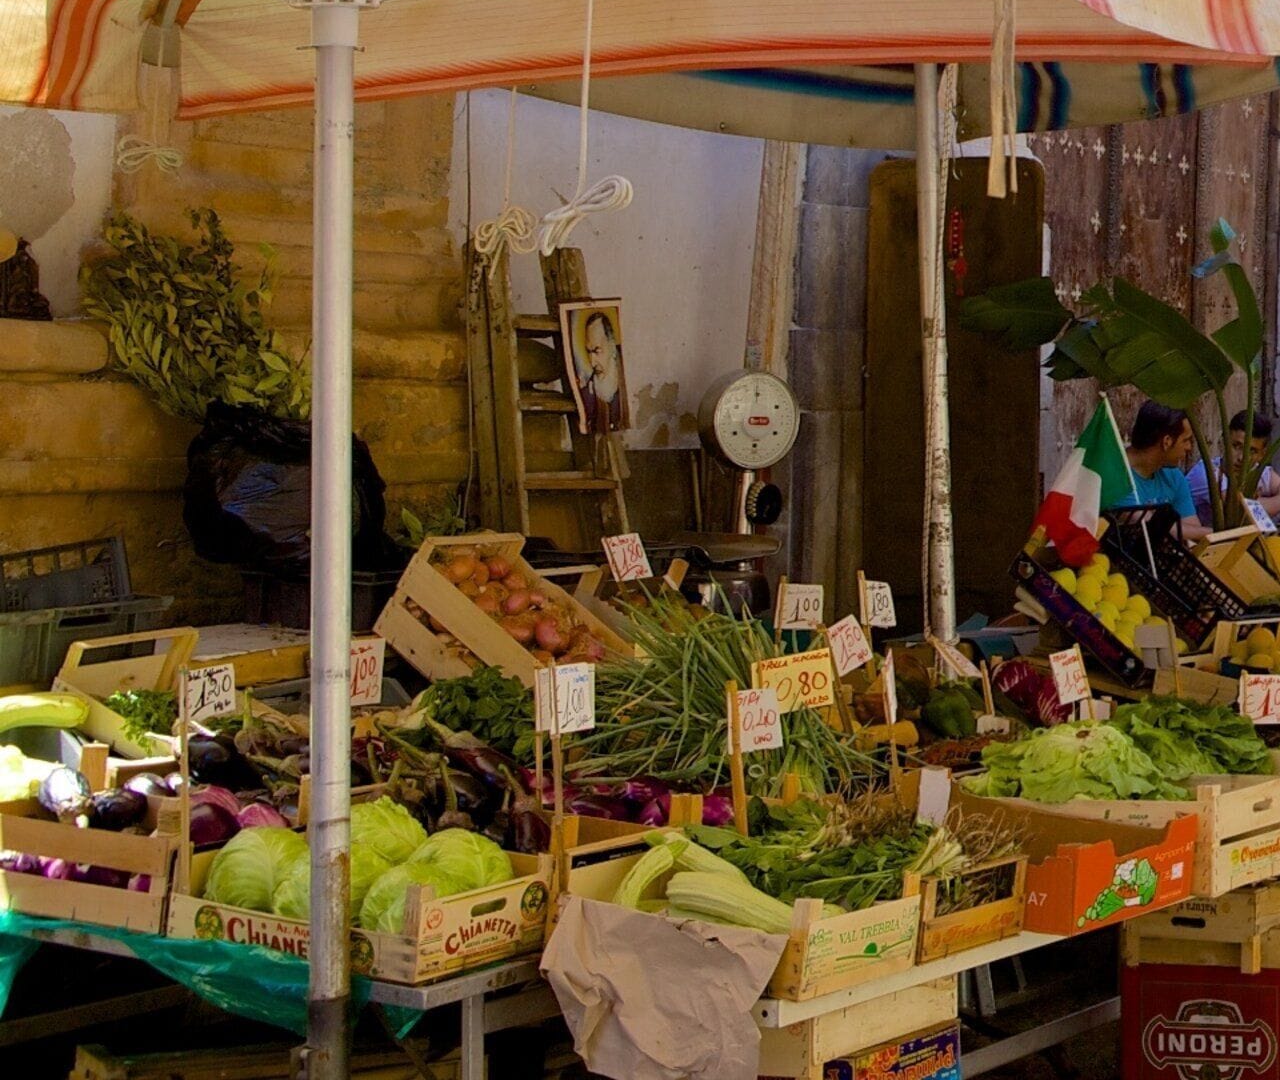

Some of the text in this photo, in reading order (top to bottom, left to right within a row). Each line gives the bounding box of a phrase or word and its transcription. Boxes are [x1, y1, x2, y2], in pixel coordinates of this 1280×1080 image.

[1028, 892, 1048, 906] A7
[839, 918, 900, 945] VAL TREBBIA
[1158, 1032, 1262, 1056] PERONI
